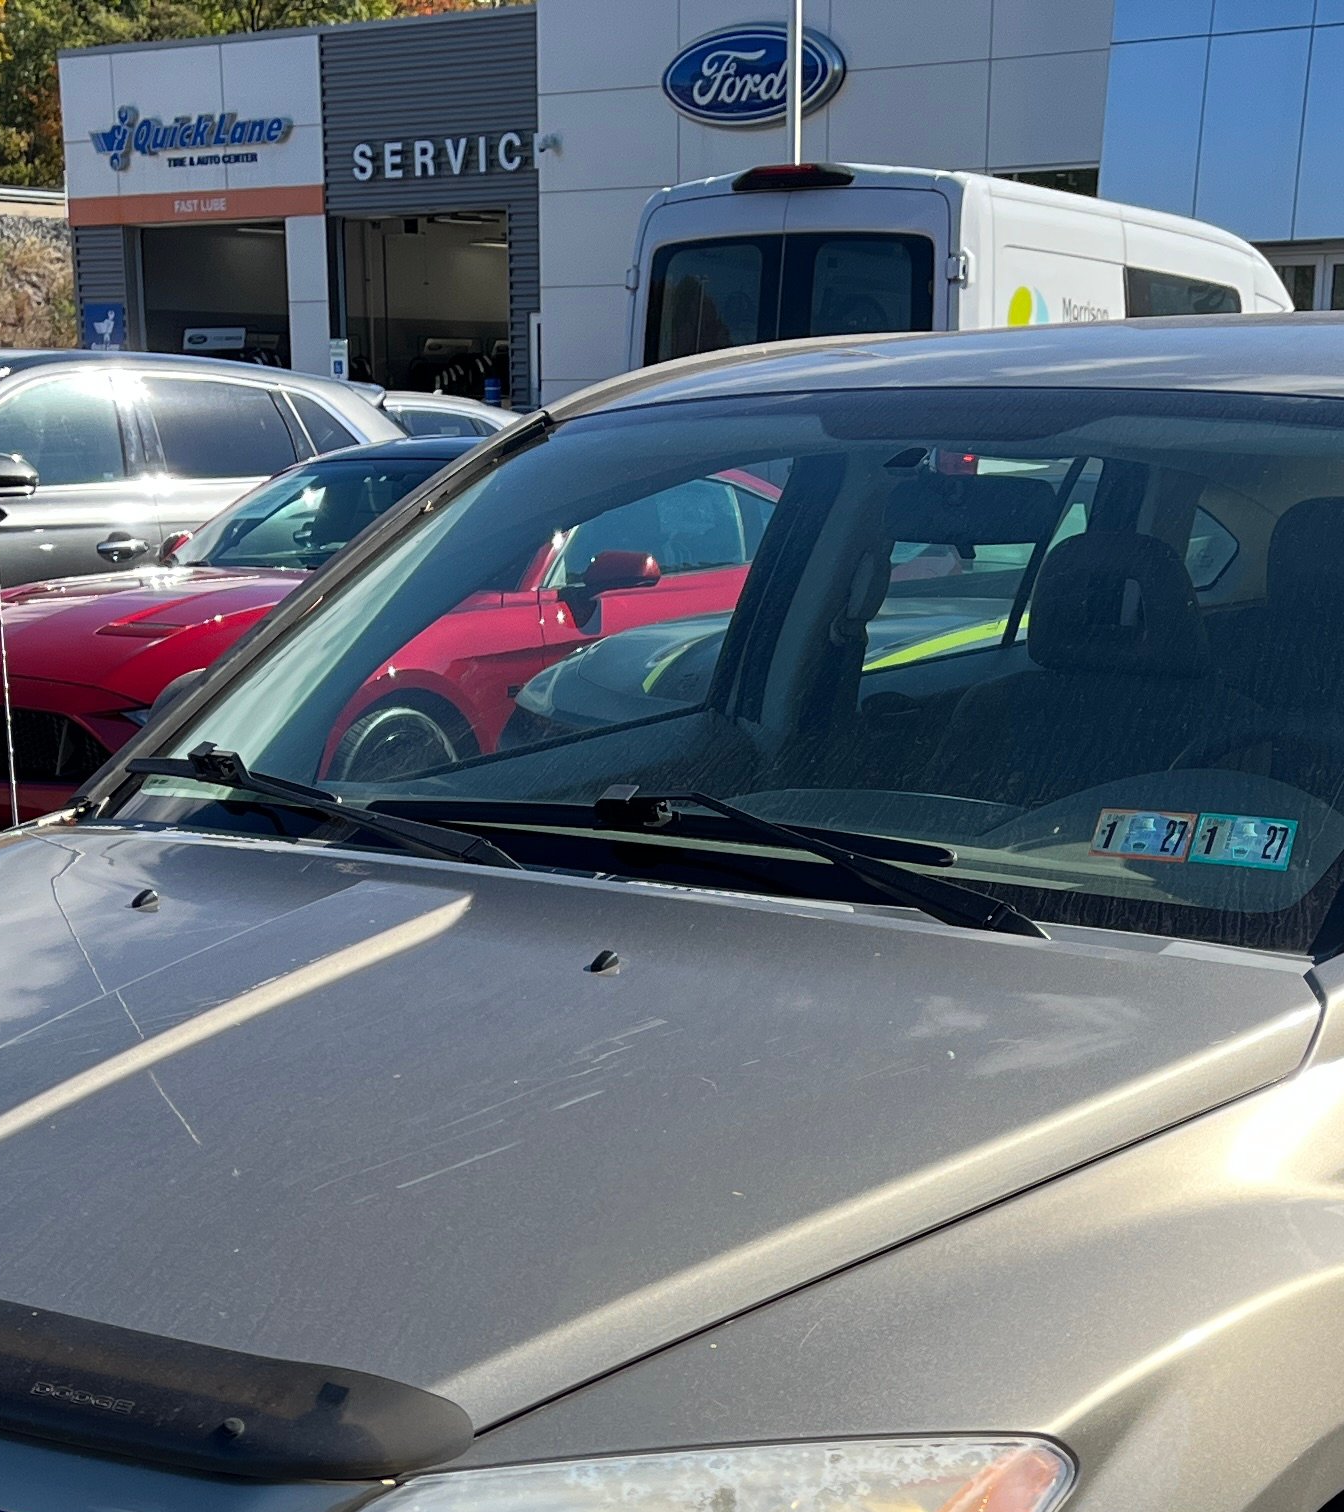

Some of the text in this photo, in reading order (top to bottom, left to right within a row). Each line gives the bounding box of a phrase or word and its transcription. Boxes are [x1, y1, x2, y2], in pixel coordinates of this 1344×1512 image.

[693, 49, 788, 106] Ford
[133, 112, 284, 156] Quick Lane
[196, 155, 220, 166] AUTO
[222, 153, 258, 165] CENTER
[174, 198, 227, 213] FAST LUBE
[1062, 297, 1109, 322] Morrison
[1160, 820, 1188, 856] 27
[1261, 826, 1289, 861] 27
[30, 1381, 136, 1415] DODGE
